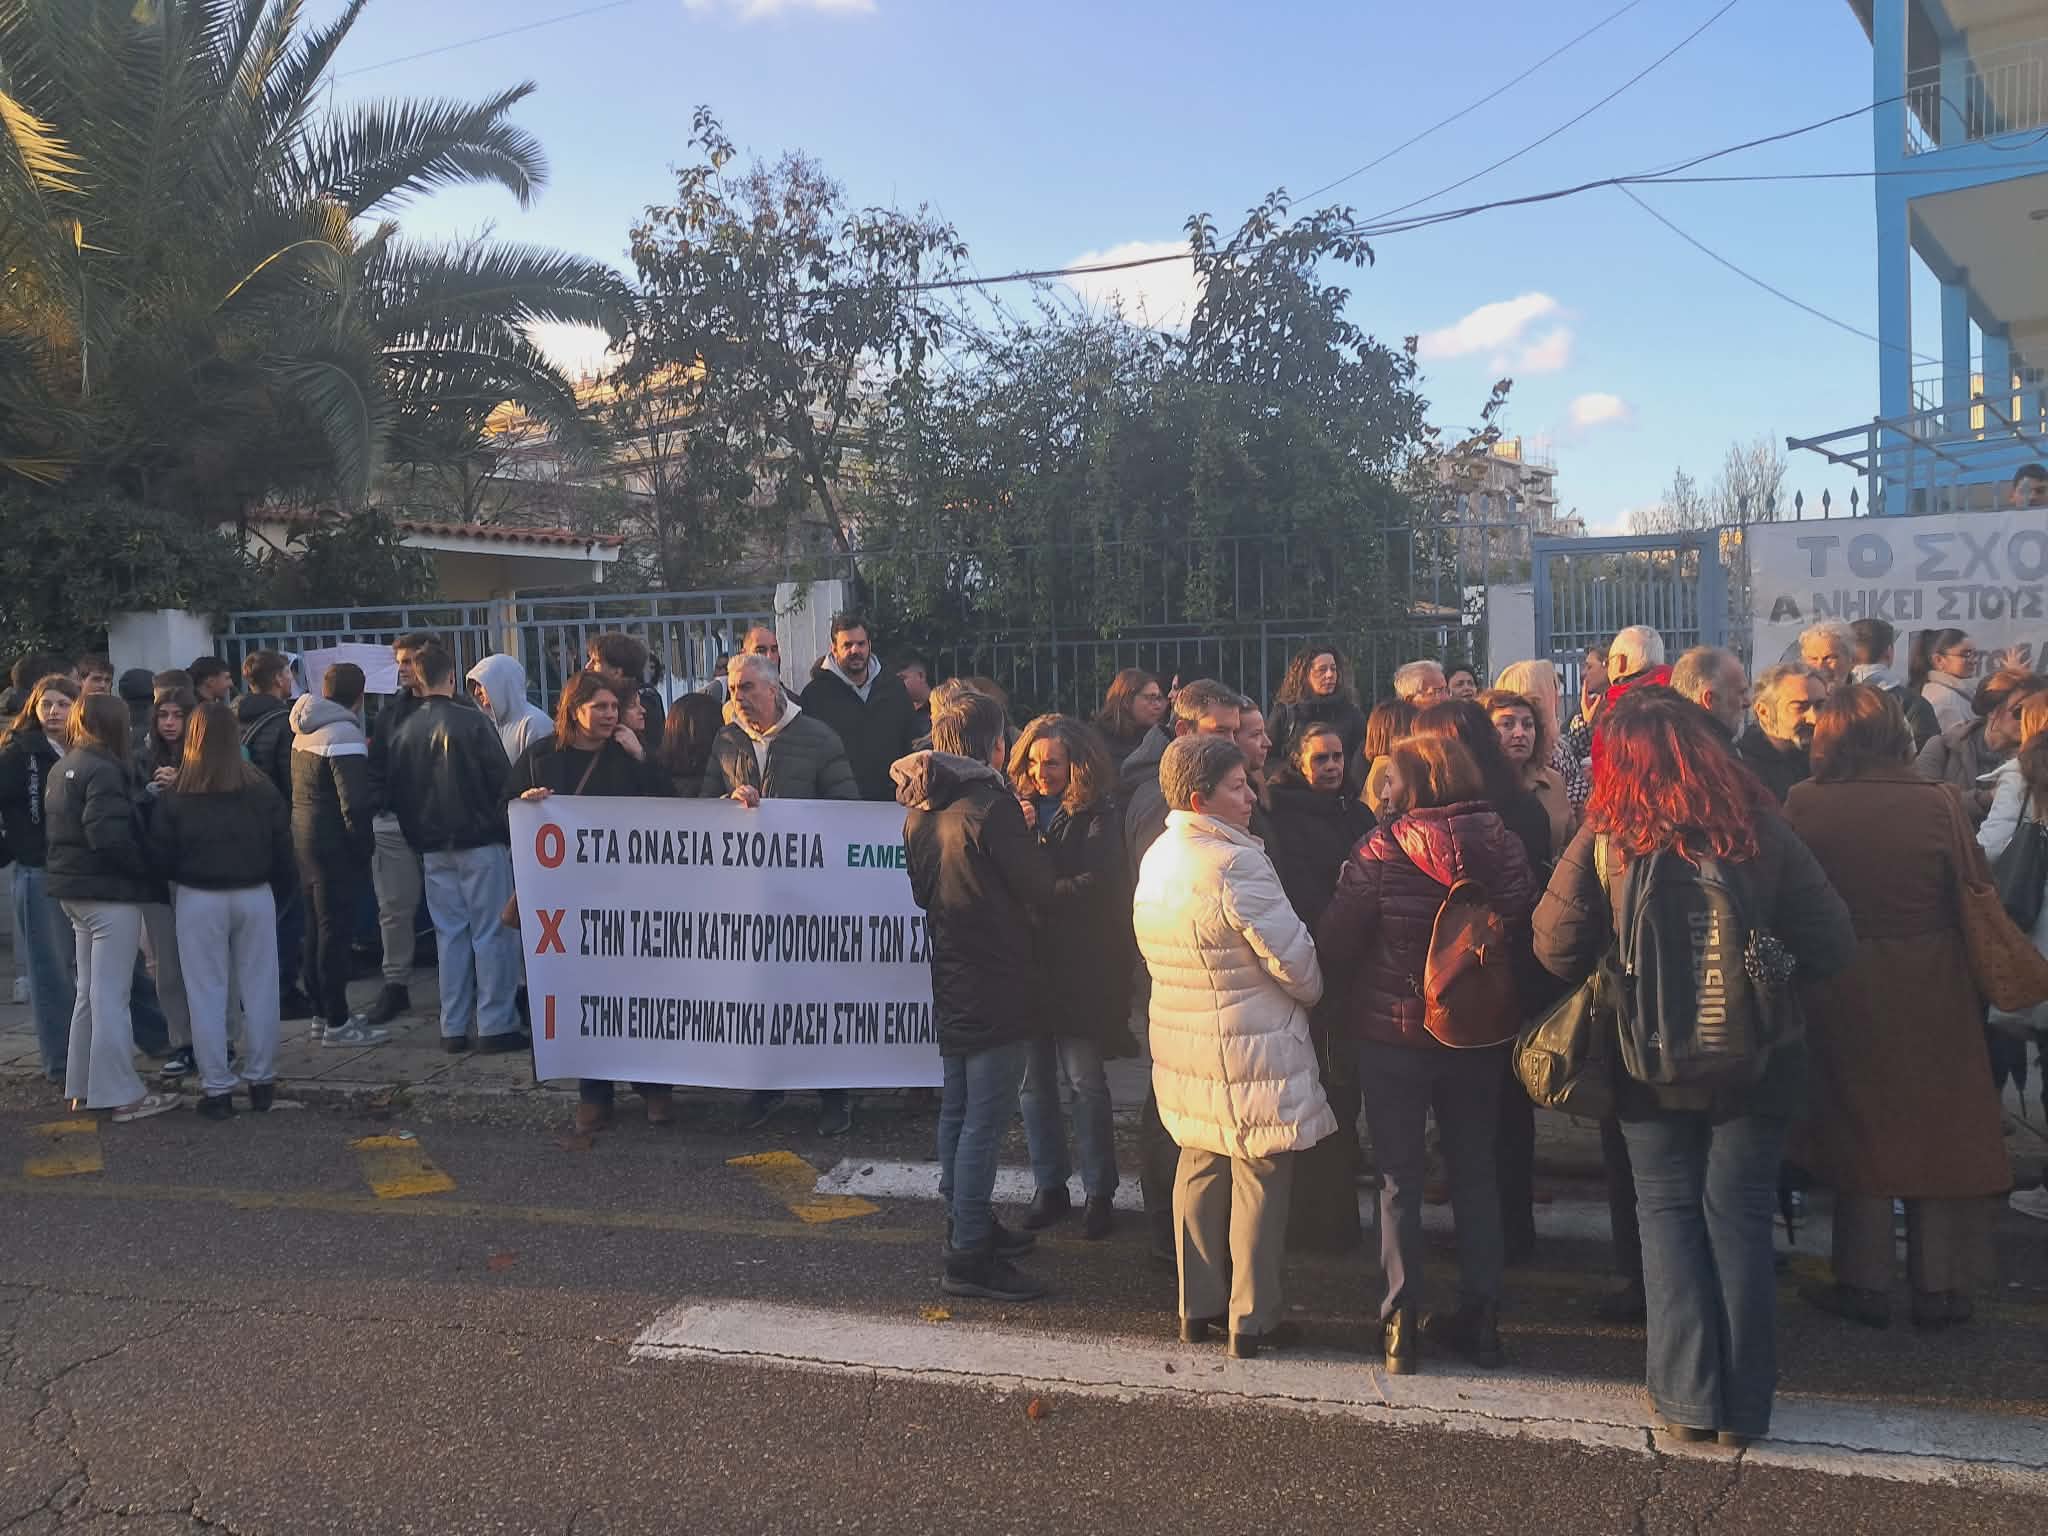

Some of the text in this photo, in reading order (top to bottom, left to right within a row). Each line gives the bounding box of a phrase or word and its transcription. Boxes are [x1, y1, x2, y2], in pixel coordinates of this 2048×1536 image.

[1797, 530, 2048, 582] ΤΟ ΣΧΟ
[1937, 584, 2043, 621] ΣΤΟΥΣ
[576, 829, 620, 864] ΣΤΑ
[628, 829, 714, 866] ΩΝΑΣΙΑ
[722, 831, 825, 868] ΣΧΟΛΕΙΑ
[847, 843, 907, 869] ΕΛΜΕ
[580, 909, 625, 957] ΣΤΗΝ
[630, 910, 693, 959] ΤΑΞΙΚΗ
[698, 911, 863, 963] ΚΑΤΗΓΟΡΙΟΠΟΙΗΣΗ
[869, 915, 904, 963] ΤΩΝ
[581, 995, 623, 1037] ΣΤΗΝ
[628, 996, 765, 1045] ΕΠΙΧΕΙΡΗΜΑΤΙΚΗ
[770, 1003, 828, 1045] ΔΡΑΣΗ
[833, 1002, 880, 1044] ΣΤΗΝ
